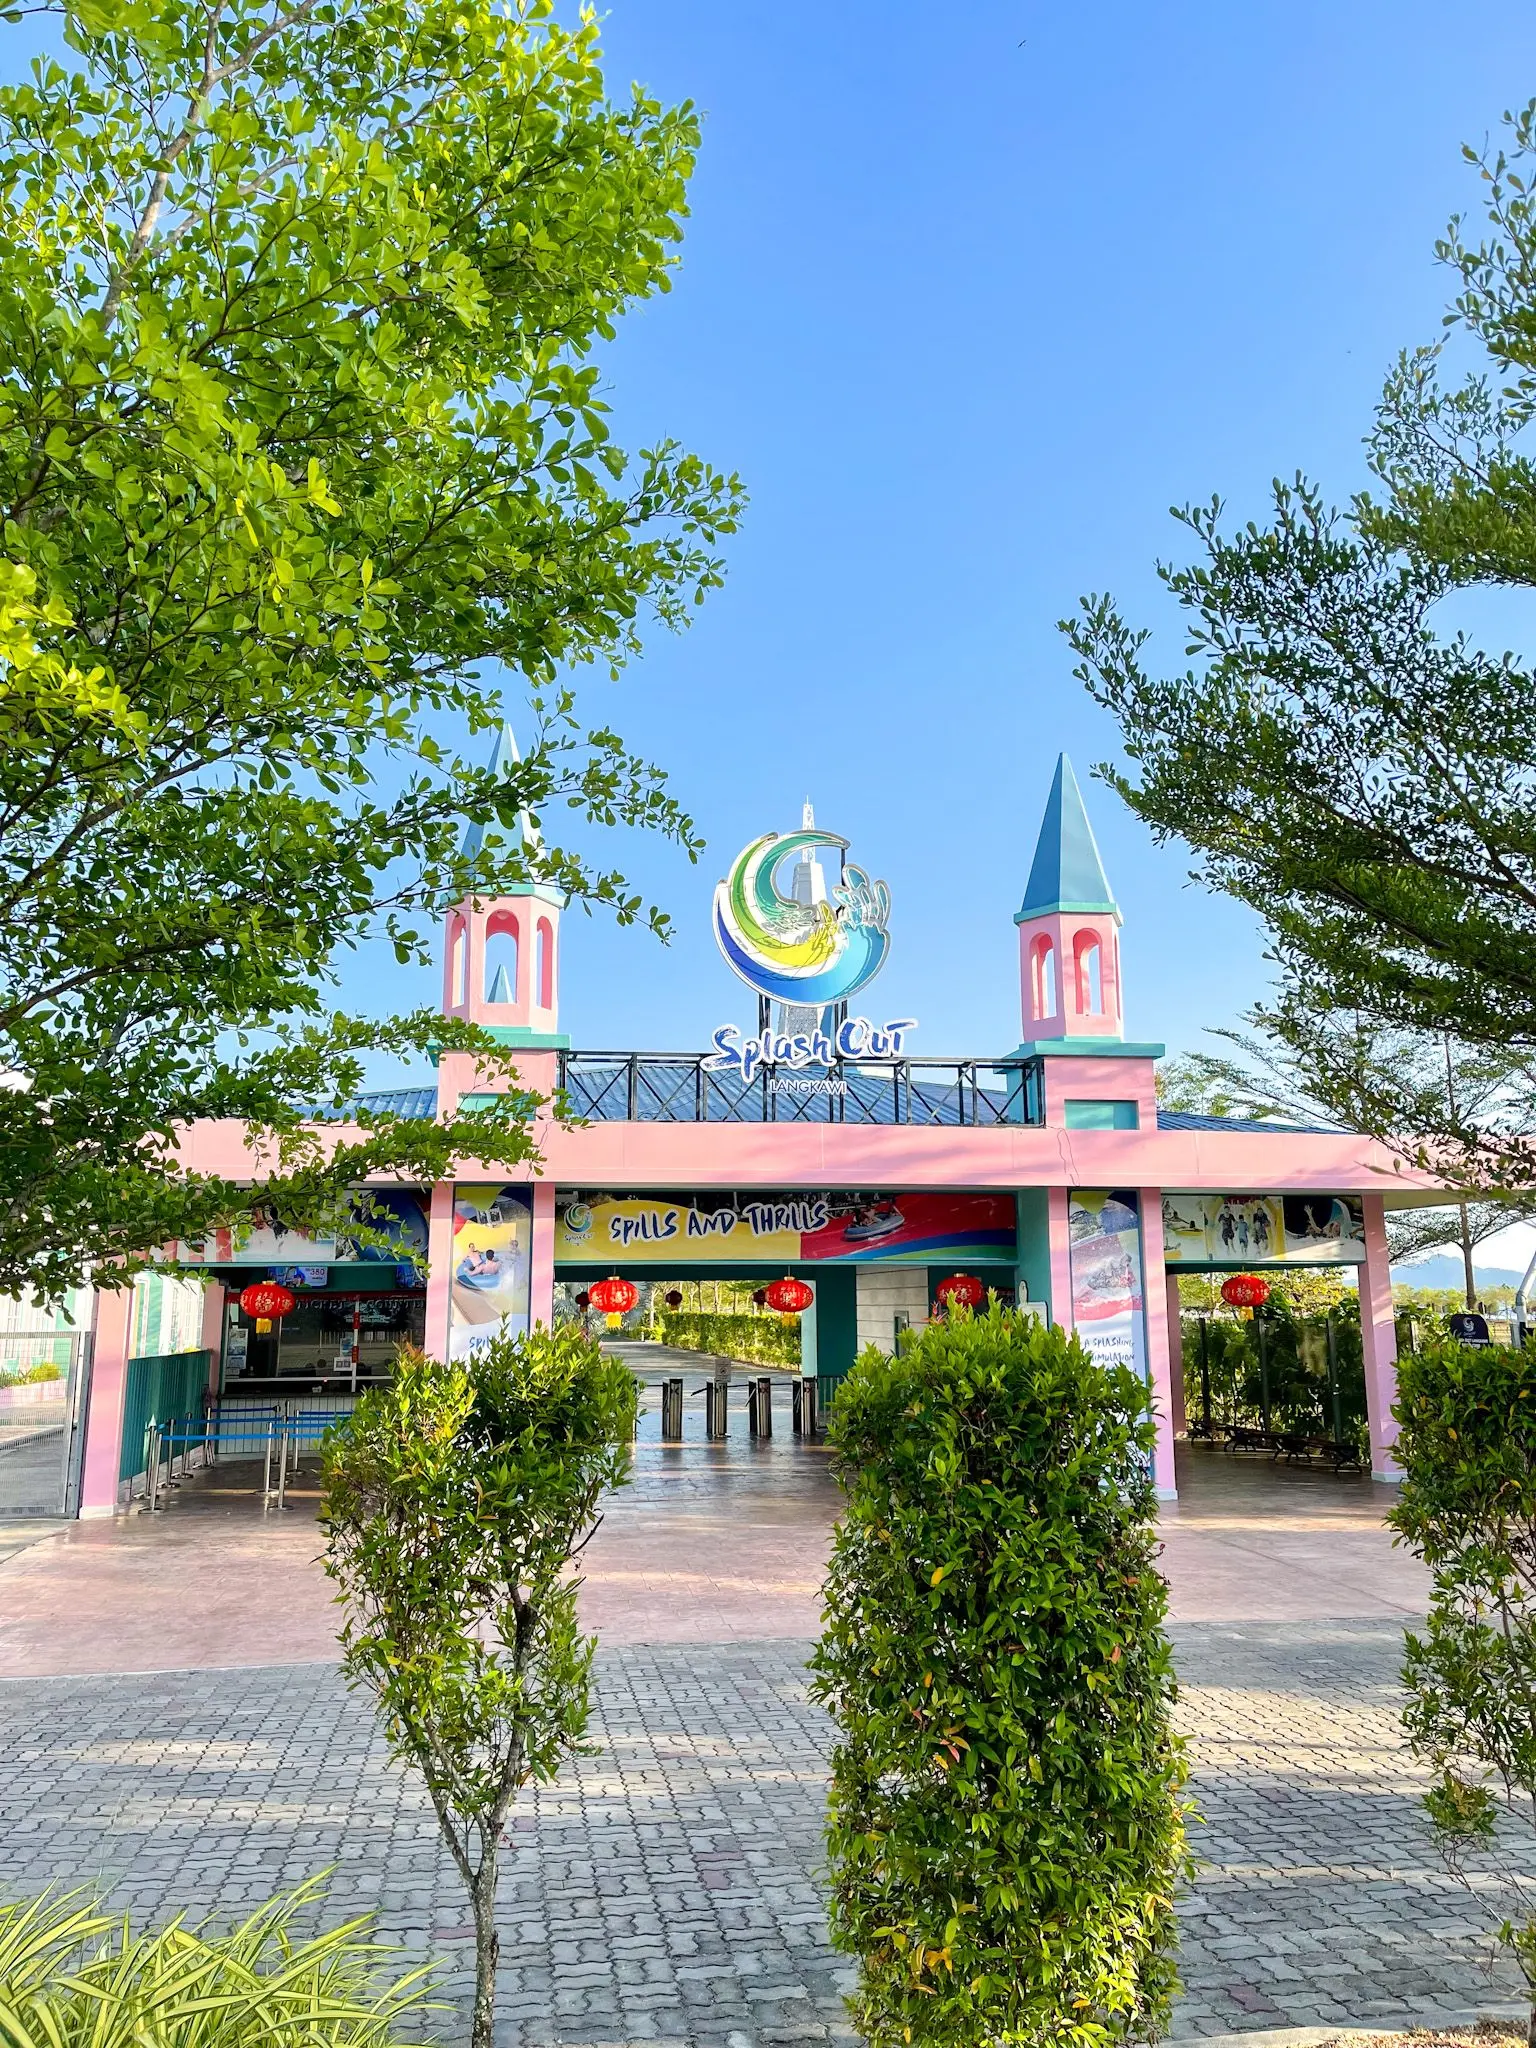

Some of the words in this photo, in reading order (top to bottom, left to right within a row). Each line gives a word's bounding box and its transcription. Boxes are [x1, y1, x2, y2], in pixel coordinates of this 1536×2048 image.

[701, 1025, 836, 1081] Splash
[769, 1079, 847, 1095] LANGKAWI
[610, 1210, 679, 1246] SPILLS
[686, 1205, 737, 1237] AND
[746, 1202, 828, 1236] THRILLS
